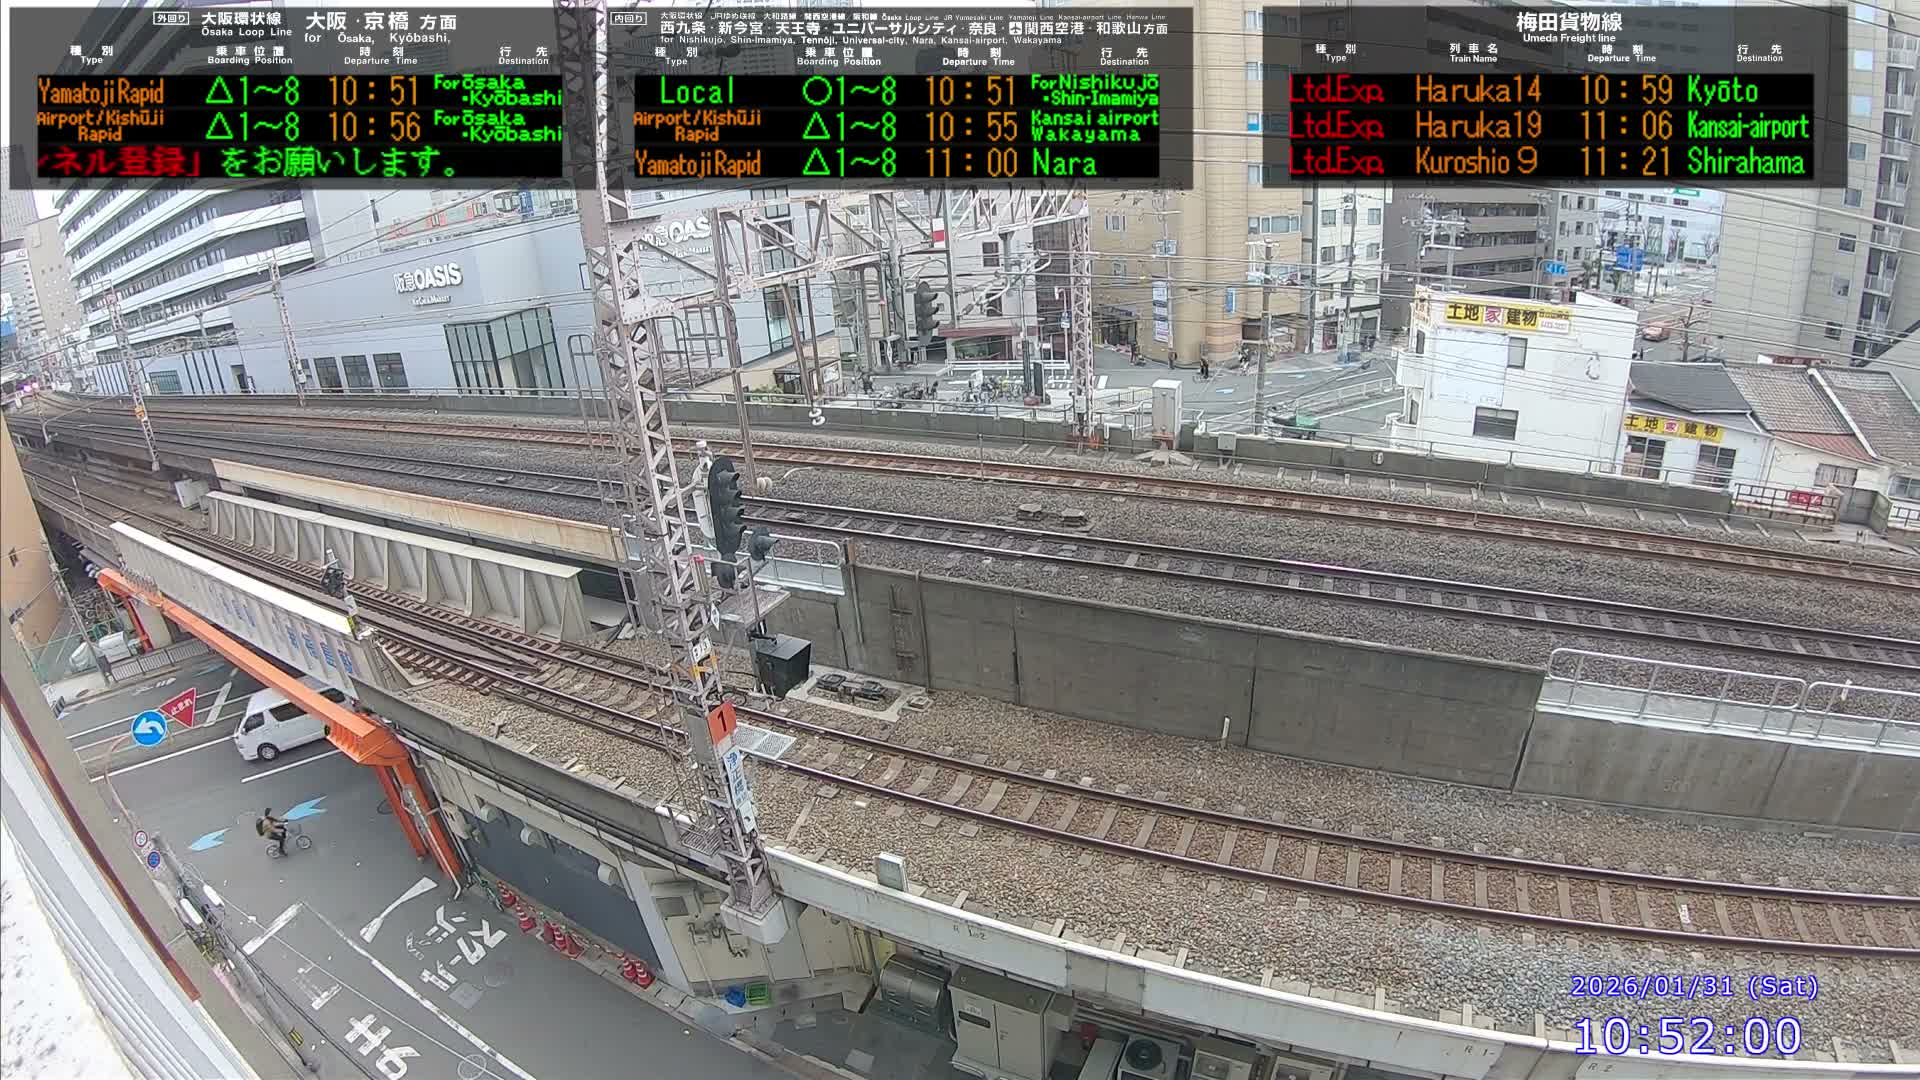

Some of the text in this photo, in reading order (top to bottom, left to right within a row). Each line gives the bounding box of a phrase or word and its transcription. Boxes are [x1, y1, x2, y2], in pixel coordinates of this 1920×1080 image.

[717, 710, 727, 732] 1
[420, 919, 508, 992] スクール
